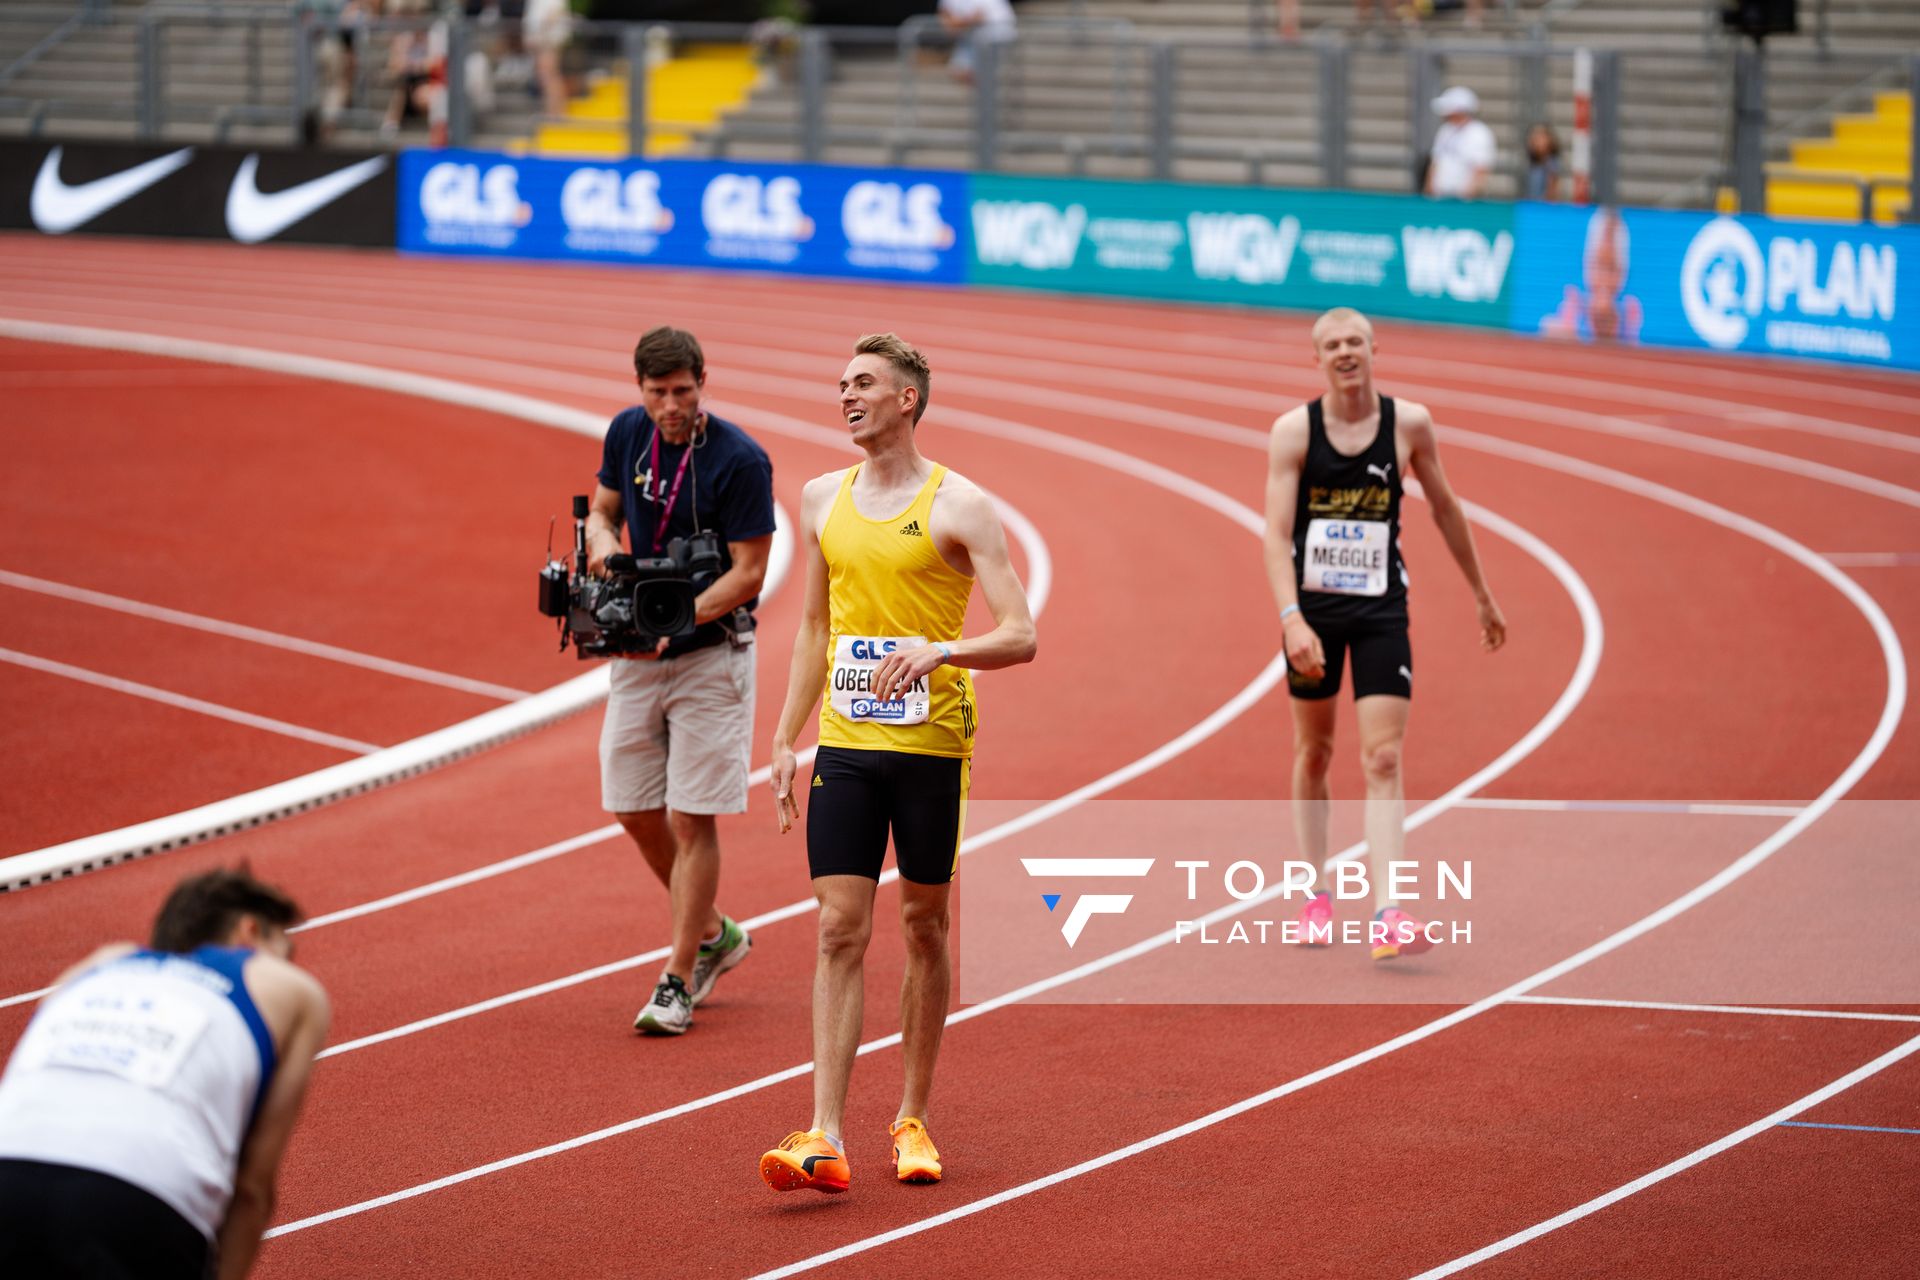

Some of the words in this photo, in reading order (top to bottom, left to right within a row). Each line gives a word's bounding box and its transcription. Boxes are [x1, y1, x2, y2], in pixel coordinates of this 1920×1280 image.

[971, 199, 1087, 270] WGV
[1187, 211, 1300, 285] WGV
[1402, 224, 1514, 303] WGV
[1767, 236, 1896, 321] PLAN
[900, 529, 922, 537] adidas
[1326, 524, 1364, 540] GLS
[1312, 546, 1382, 569] MEGGLE
[835, 667, 925, 693] OBEK
[872, 702, 903, 712] PLAN
[914, 701, 923, 716] 415
